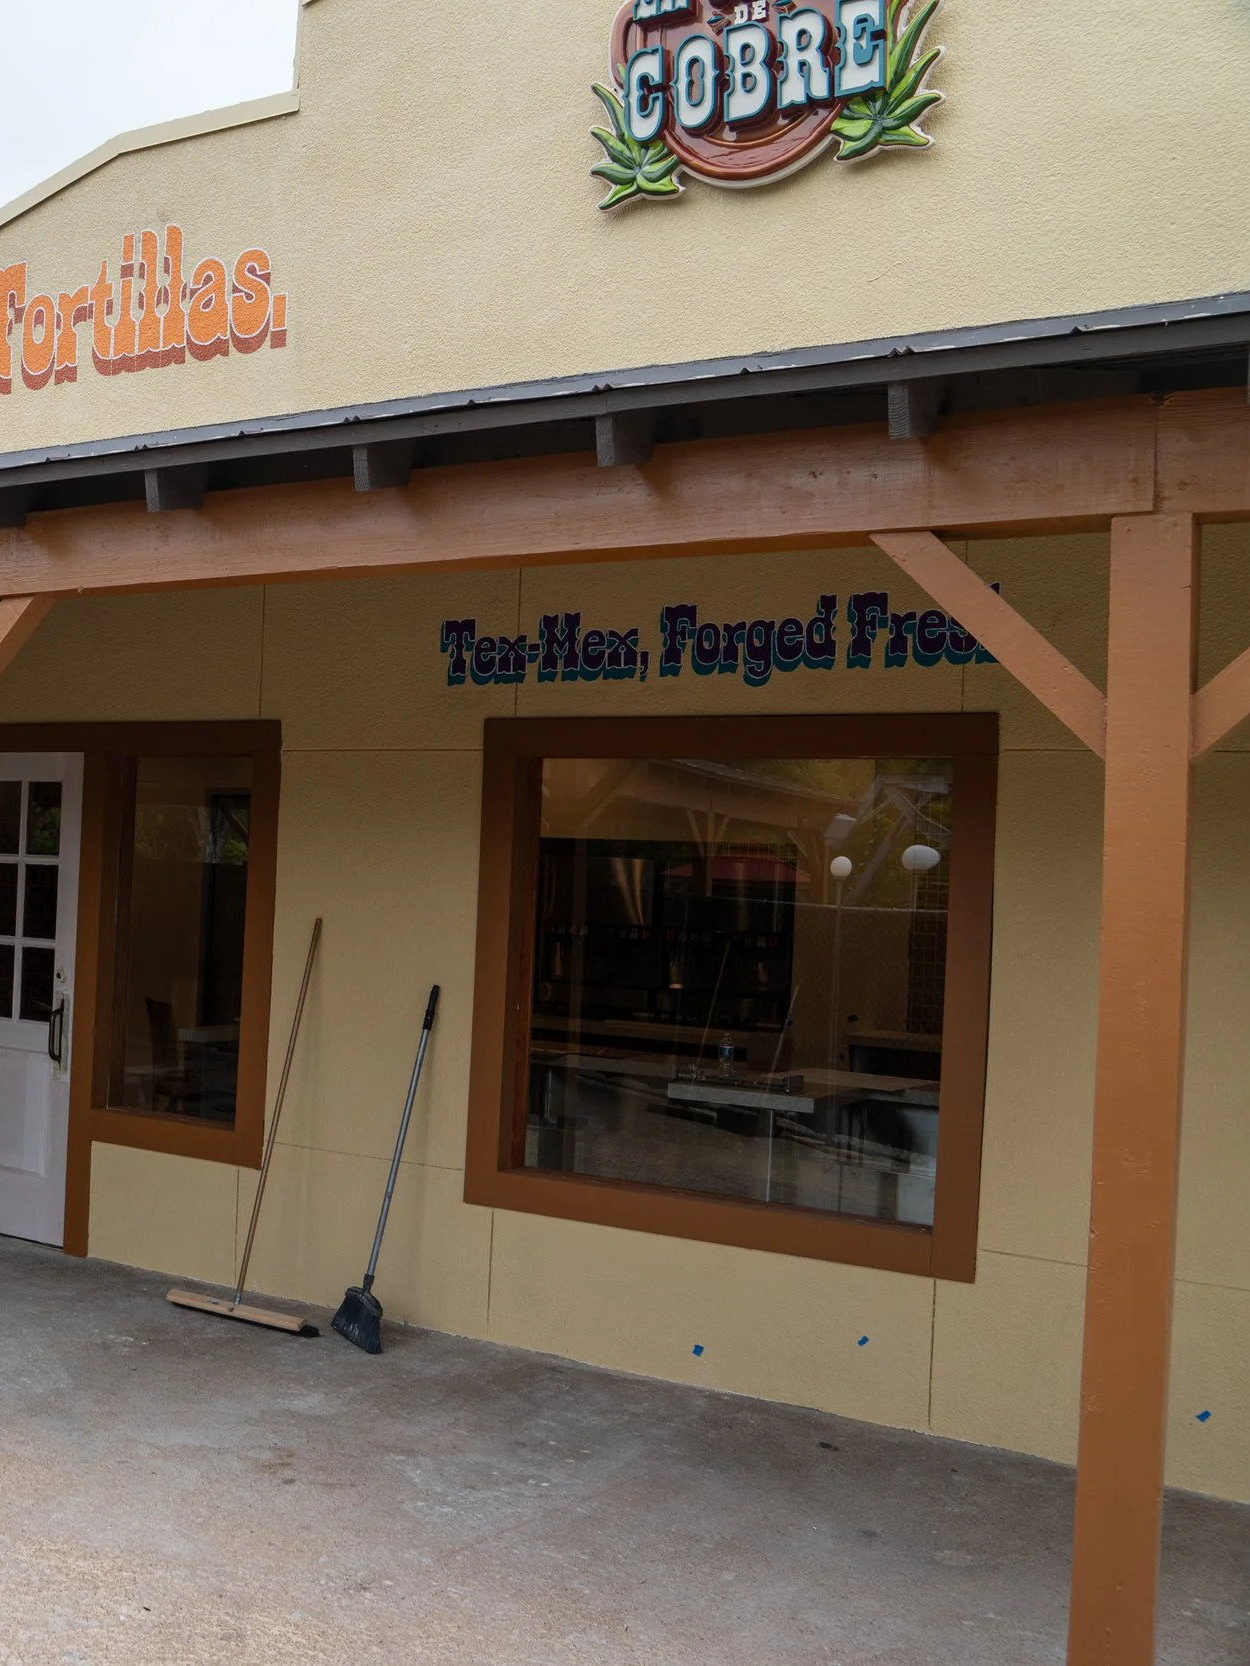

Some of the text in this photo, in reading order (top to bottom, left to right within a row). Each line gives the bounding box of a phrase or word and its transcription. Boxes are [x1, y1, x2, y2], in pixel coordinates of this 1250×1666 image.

[733, 0, 768, 25] DE
[622, 0, 888, 143] COBRE
[440, 582, 1000, 687] Tex-Mex, Forged Fres
